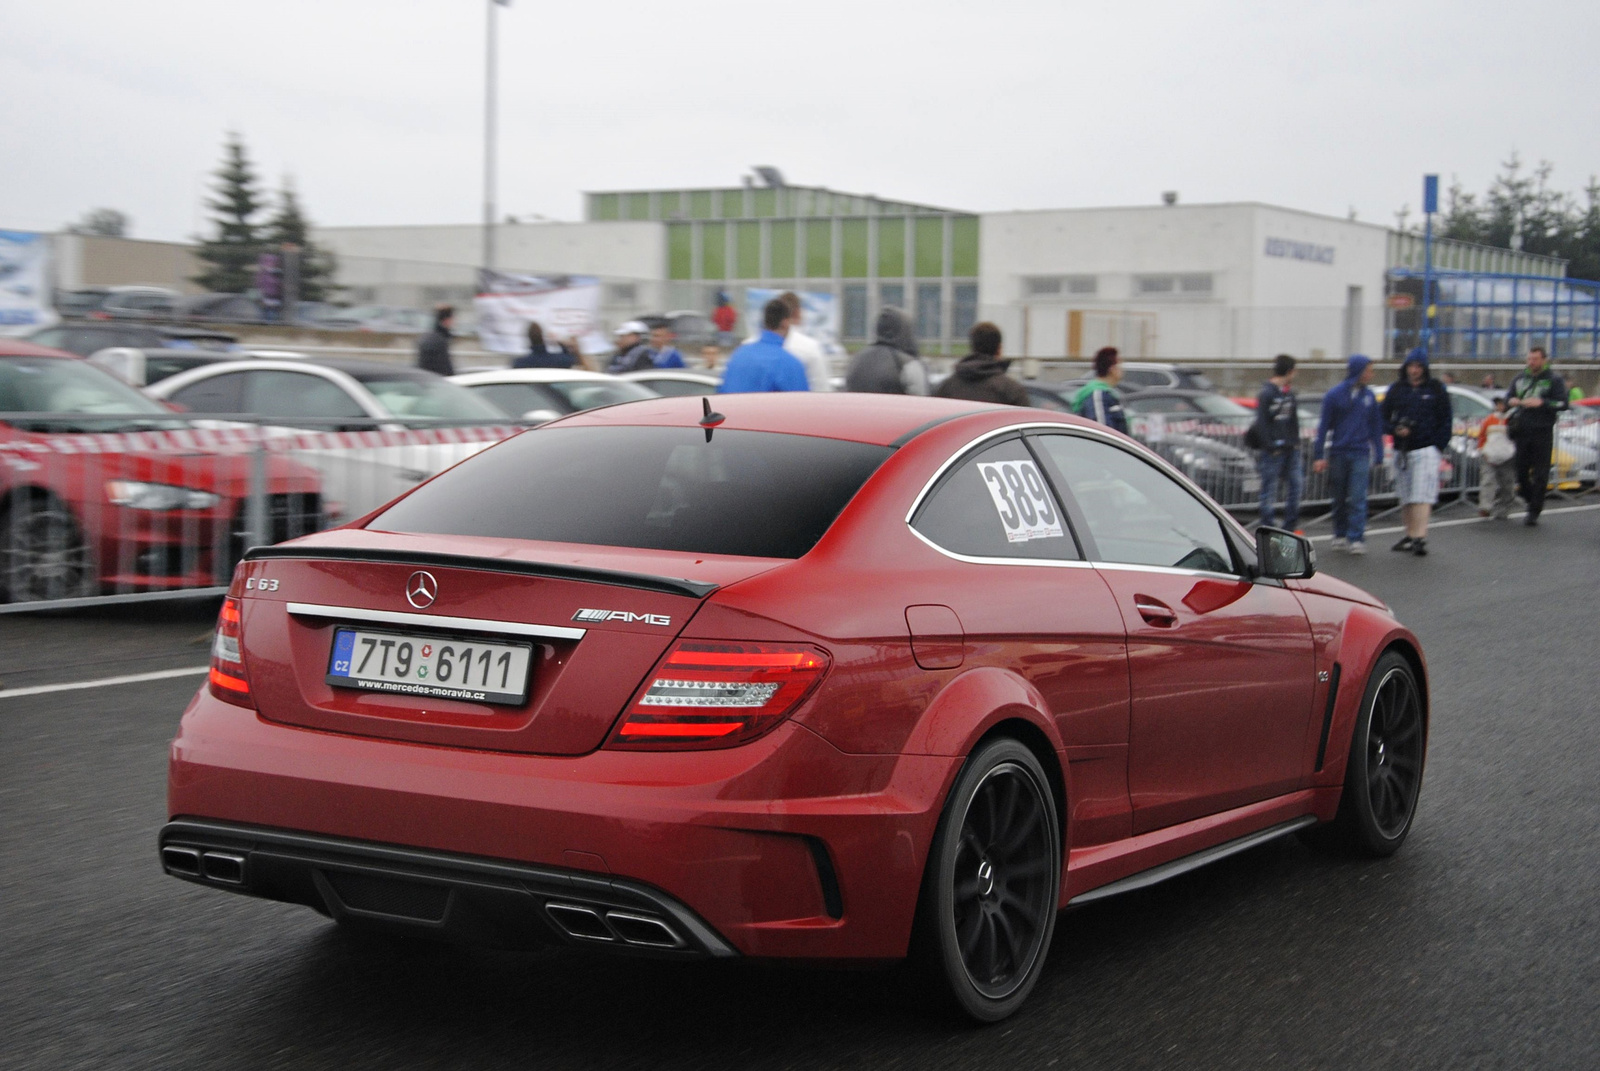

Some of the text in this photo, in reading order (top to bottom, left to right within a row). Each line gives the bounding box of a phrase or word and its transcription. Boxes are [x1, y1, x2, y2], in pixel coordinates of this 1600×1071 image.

[984, 463, 1055, 530] 389
[246, 577, 279, 591] C 63
[606, 610, 671, 626] AMG
[334, 660, 349, 672] CZ
[357, 638, 512, 689] 7T9 6111
[357, 679, 486, 700] www.mercedes-moravia.cz
